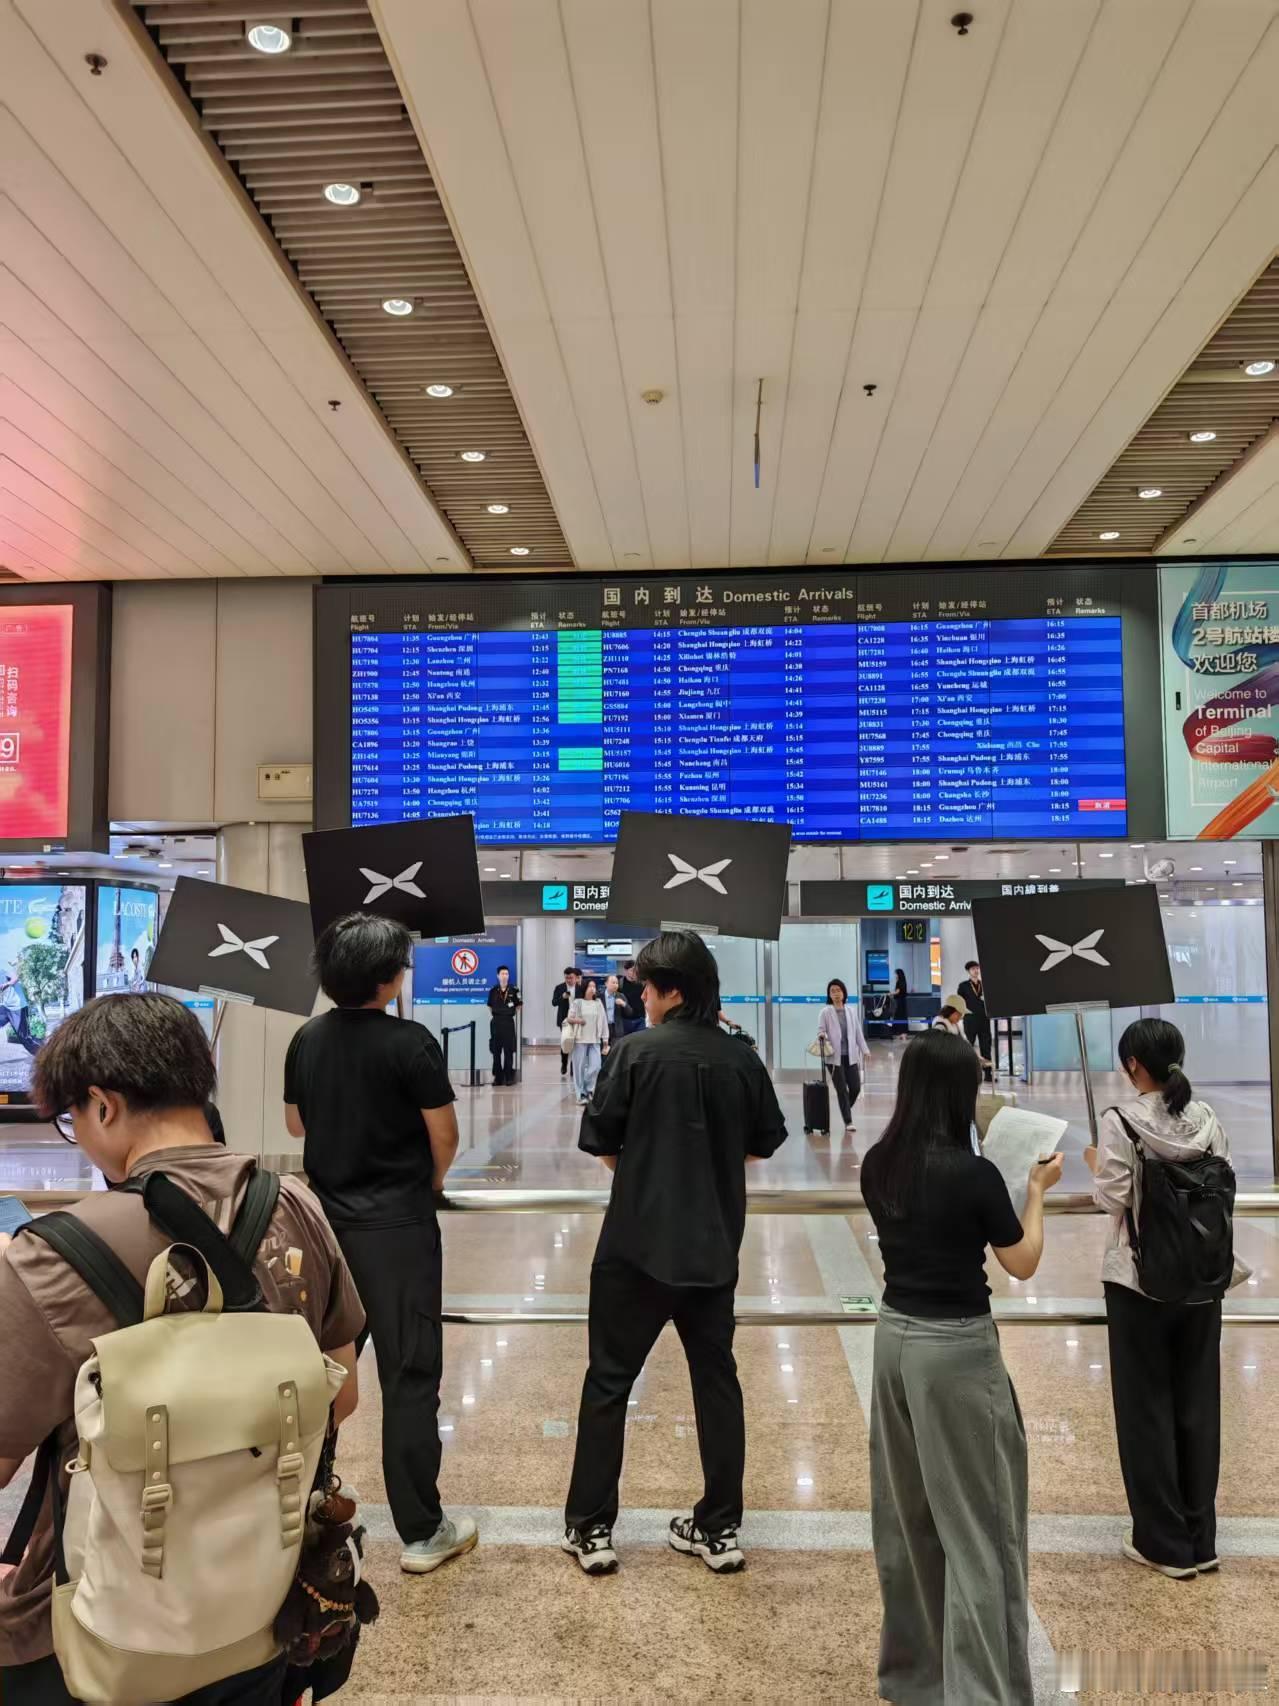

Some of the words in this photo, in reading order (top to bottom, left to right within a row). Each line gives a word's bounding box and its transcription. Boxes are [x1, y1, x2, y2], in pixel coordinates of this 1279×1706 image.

[724, 590, 790, 603] Domestic
[798, 588, 854, 601] Arrivals
[1192, 602, 1268, 619] 首都机场
[936, 622, 972, 631] Guangzhou
[1192, 627, 1279, 645] 2号航站楼
[678, 641, 707, 649] Shanghai
[709, 641, 740, 649] Hongqiao
[937, 659, 966, 667] Shanghai
[969, 658, 1001, 666] Hongqiao
[1192, 652, 1257, 672] 欢迎您
[427, 669, 453, 677] Nantong
[678, 665, 712, 673] Chongqing
[937, 671, 966, 679] Chengdu
[679, 689, 704, 697] Jiujiang
[1195, 688, 1251, 699] Welcome
[1255, 690, 1267, 699] to
[937, 707, 967, 715] Shanghai
[970, 706, 1002, 714] Hongqiao
[1196, 704, 1272, 719] Terminal
[427, 716, 456, 725] Shanghai
[458, 716, 488, 724] Hongqiao
[938, 719, 973, 727] Chongqing
[938, 731, 973, 739] Chongqing
[1195, 726, 1207, 736] of
[1211, 725, 1252, 740] Beijing
[428, 740, 457, 748] Shangrao
[679, 736, 707, 744] Chengdu
[1196, 742, 1238, 756] Capital
[938, 755, 968, 763] Shanghai
[971, 755, 996, 763] Pudong
[428, 763, 456, 772] Shanghai
[458, 763, 482, 771] Pudong
[680, 760, 710, 768] Nanchang
[1197, 759, 1273, 770] International
[939, 767, 964, 775] Urumqi
[680, 783, 709, 792] Kunming
[939, 779, 969, 787] Shanghai
[971, 779, 997, 787] Pudong
[1198, 778, 1238, 790] Airport
[428, 787, 459, 795] Hangzhou
[939, 791, 971, 799] Changsha
[680, 807, 707, 815] Chengdu
[939, 803, 976, 811] Guangzhou
[574, 886, 610, 899] 国内到
[900, 885, 954, 899] 国内到达
[574, 901, 608, 910] Domest
[900, 901, 945, 910] Domestic
[950, 901, 971, 910] Arriv
